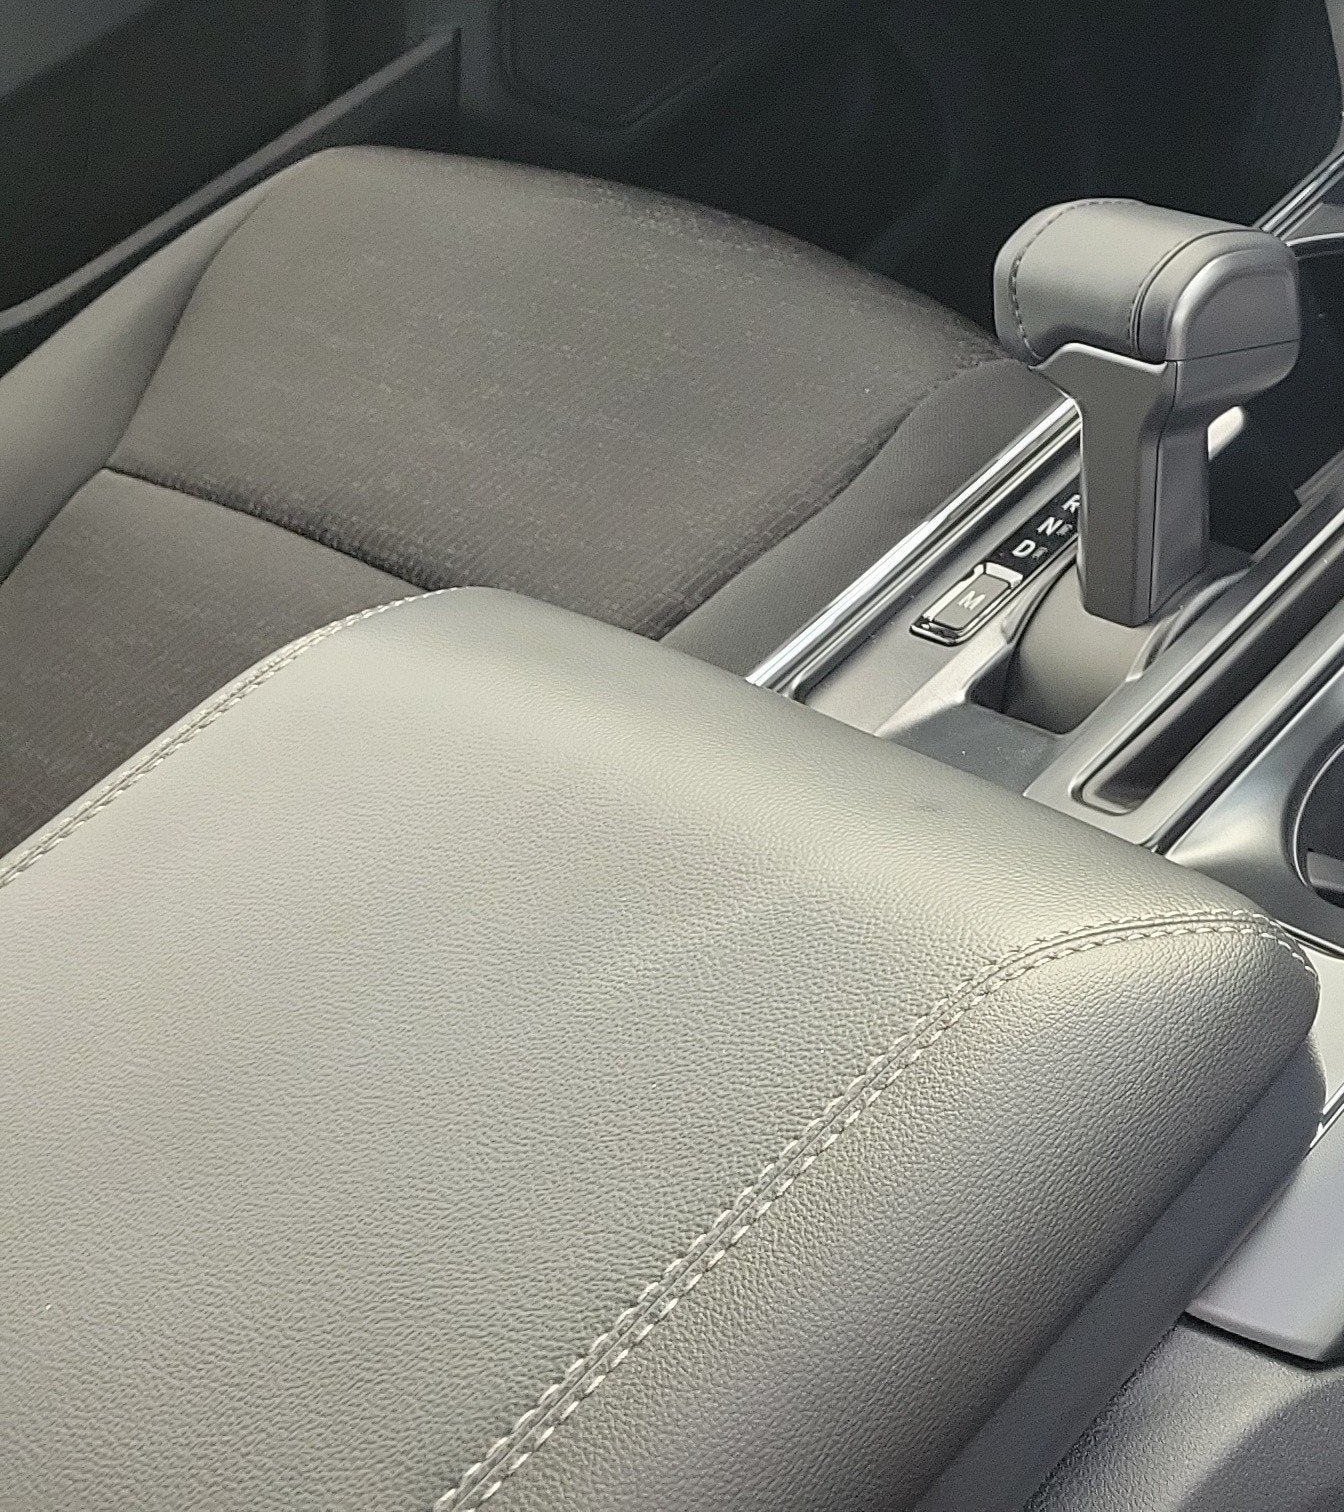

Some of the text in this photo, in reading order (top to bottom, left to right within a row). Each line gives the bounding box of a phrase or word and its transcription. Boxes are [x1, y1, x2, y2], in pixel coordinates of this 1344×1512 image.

[1036, 516, 1064, 536] N
[1011, 539, 1036, 558] D
[956, 590, 986, 611] M
